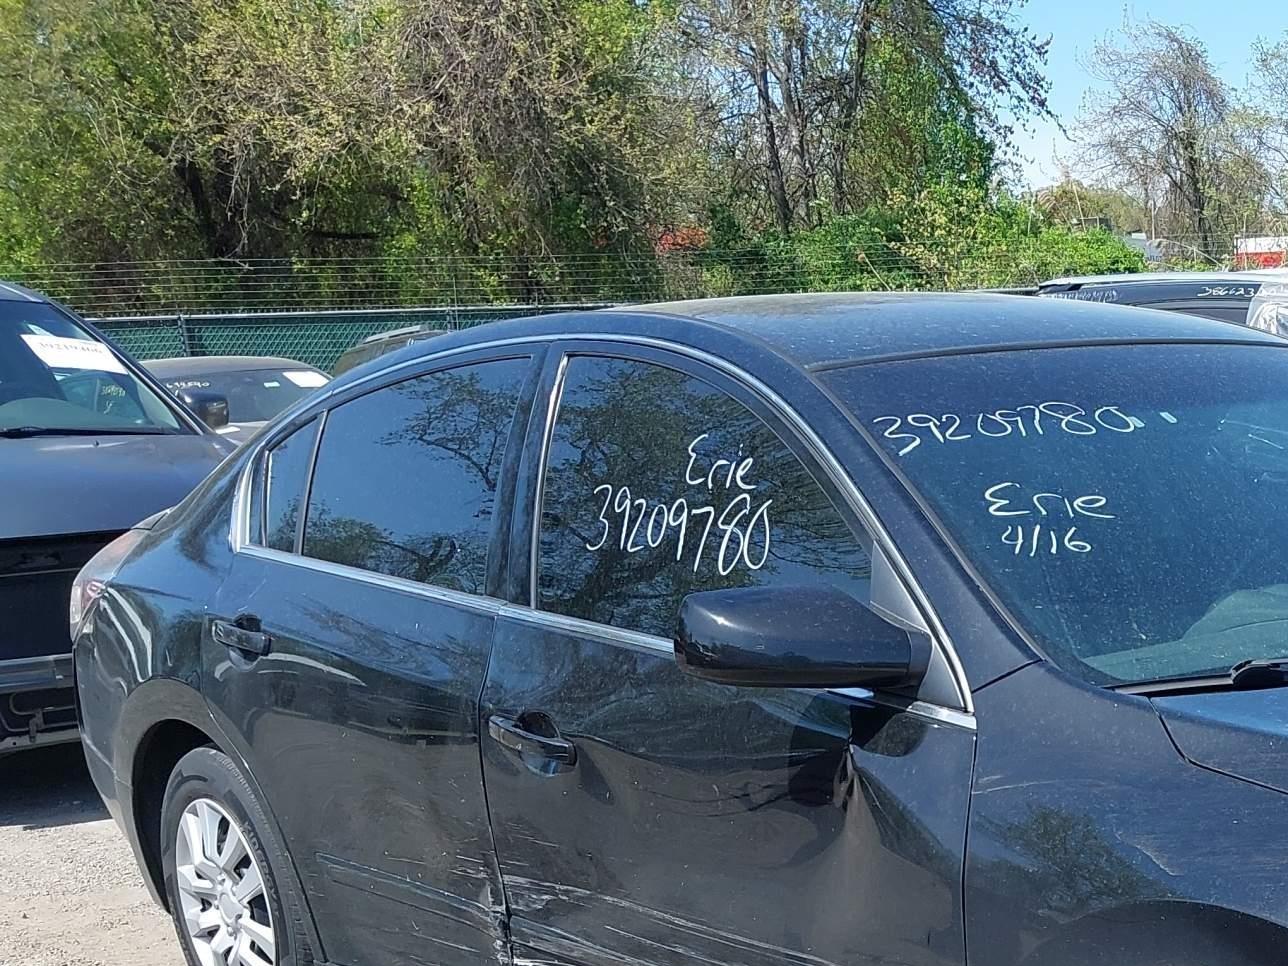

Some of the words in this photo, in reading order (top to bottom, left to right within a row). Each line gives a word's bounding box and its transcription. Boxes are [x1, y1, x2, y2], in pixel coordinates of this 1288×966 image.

[873, 401, 1137, 456] 39209780
[685, 433, 757, 490] Erie
[984, 481, 1115, 519] Erie
[586, 484, 773, 576] 39209780
[1001, 524, 1092, 556] 4/16
